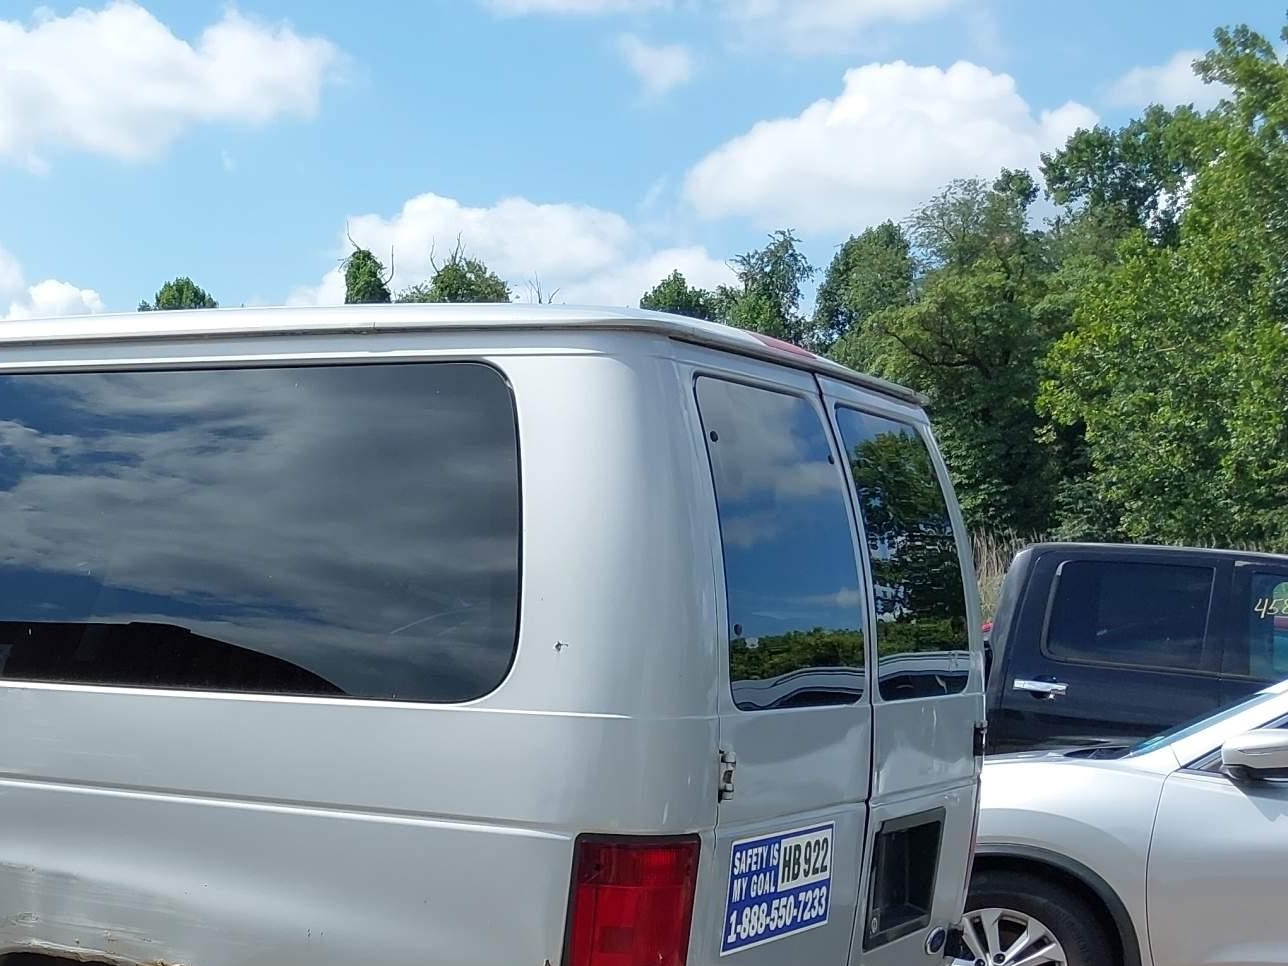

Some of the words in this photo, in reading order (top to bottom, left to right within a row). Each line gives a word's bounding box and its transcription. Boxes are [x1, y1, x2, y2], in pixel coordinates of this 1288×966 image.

[733, 845, 769, 876] SAFETY
[769, 842, 779, 867] IS
[781, 843, 802, 884] HB
[803, 837, 829, 878] 922
[732, 876, 749, 903] MY
[750, 870, 775, 898] GOAL
[727, 886, 827, 944] 1-888-550-7233
